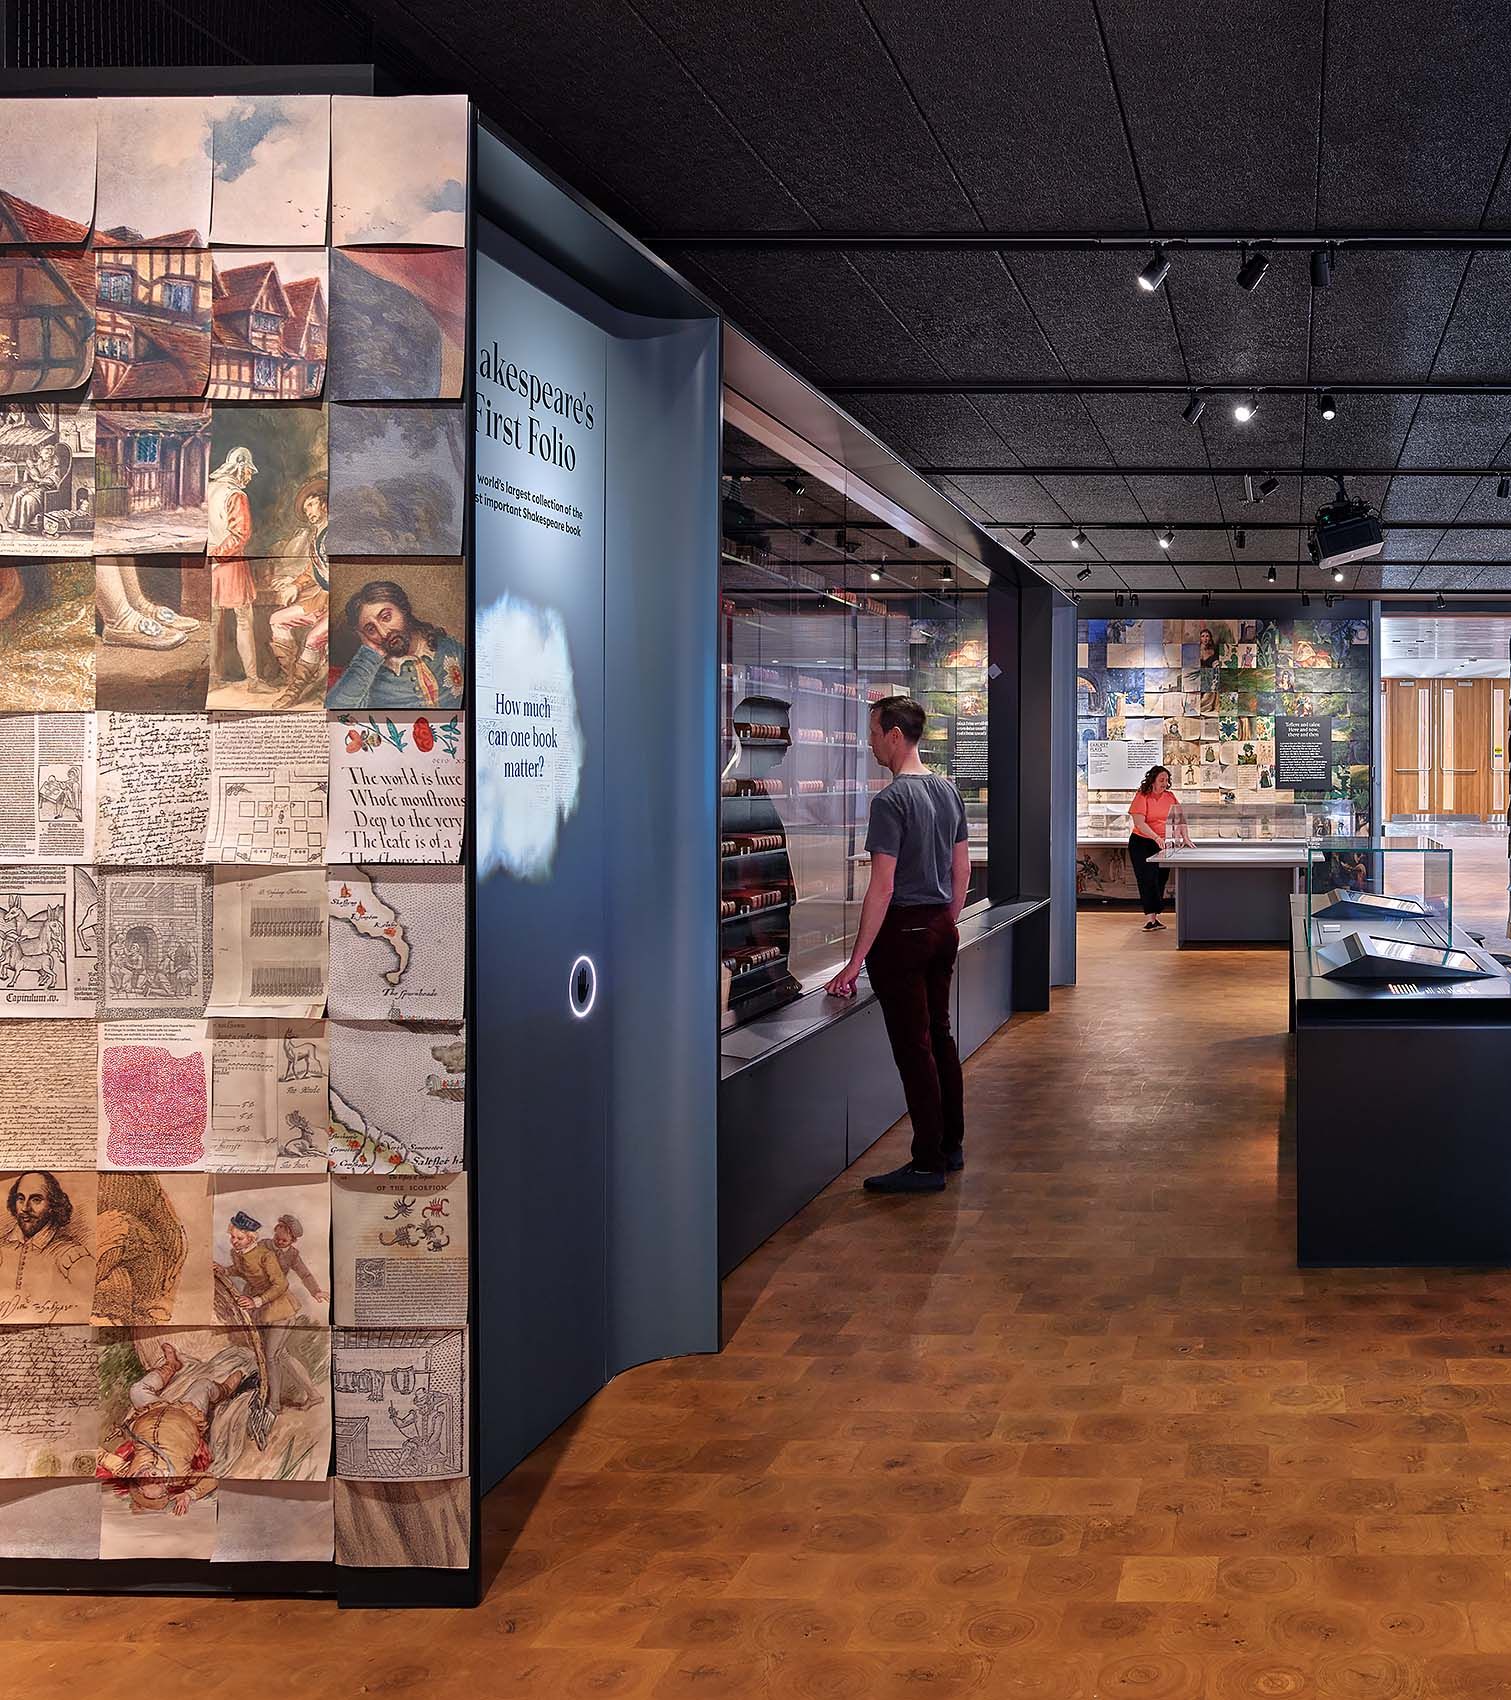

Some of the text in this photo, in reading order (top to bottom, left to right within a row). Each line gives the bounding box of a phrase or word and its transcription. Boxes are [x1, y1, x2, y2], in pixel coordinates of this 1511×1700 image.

[477, 341, 594, 430] akespeare's
[475, 392, 576, 471] First Folio
[477, 474, 583, 519] world's largest collection of the
[484, 493, 522, 518] important
[522, 507, 565, 531] Shakespeare
[565, 522, 582, 537] book
[495, 692, 551, 718] How much
[488, 725, 558, 748] can one book
[341, 767, 378, 785] The
[380, 768, 418, 785] world
[421, 773, 433, 785] is
[504, 755, 545, 778] matter?
[351, 809, 462, 835] Deep to the very
[345, 831, 377, 848] The
[415, 834, 426, 848] is
[429, 830, 443, 848] of
